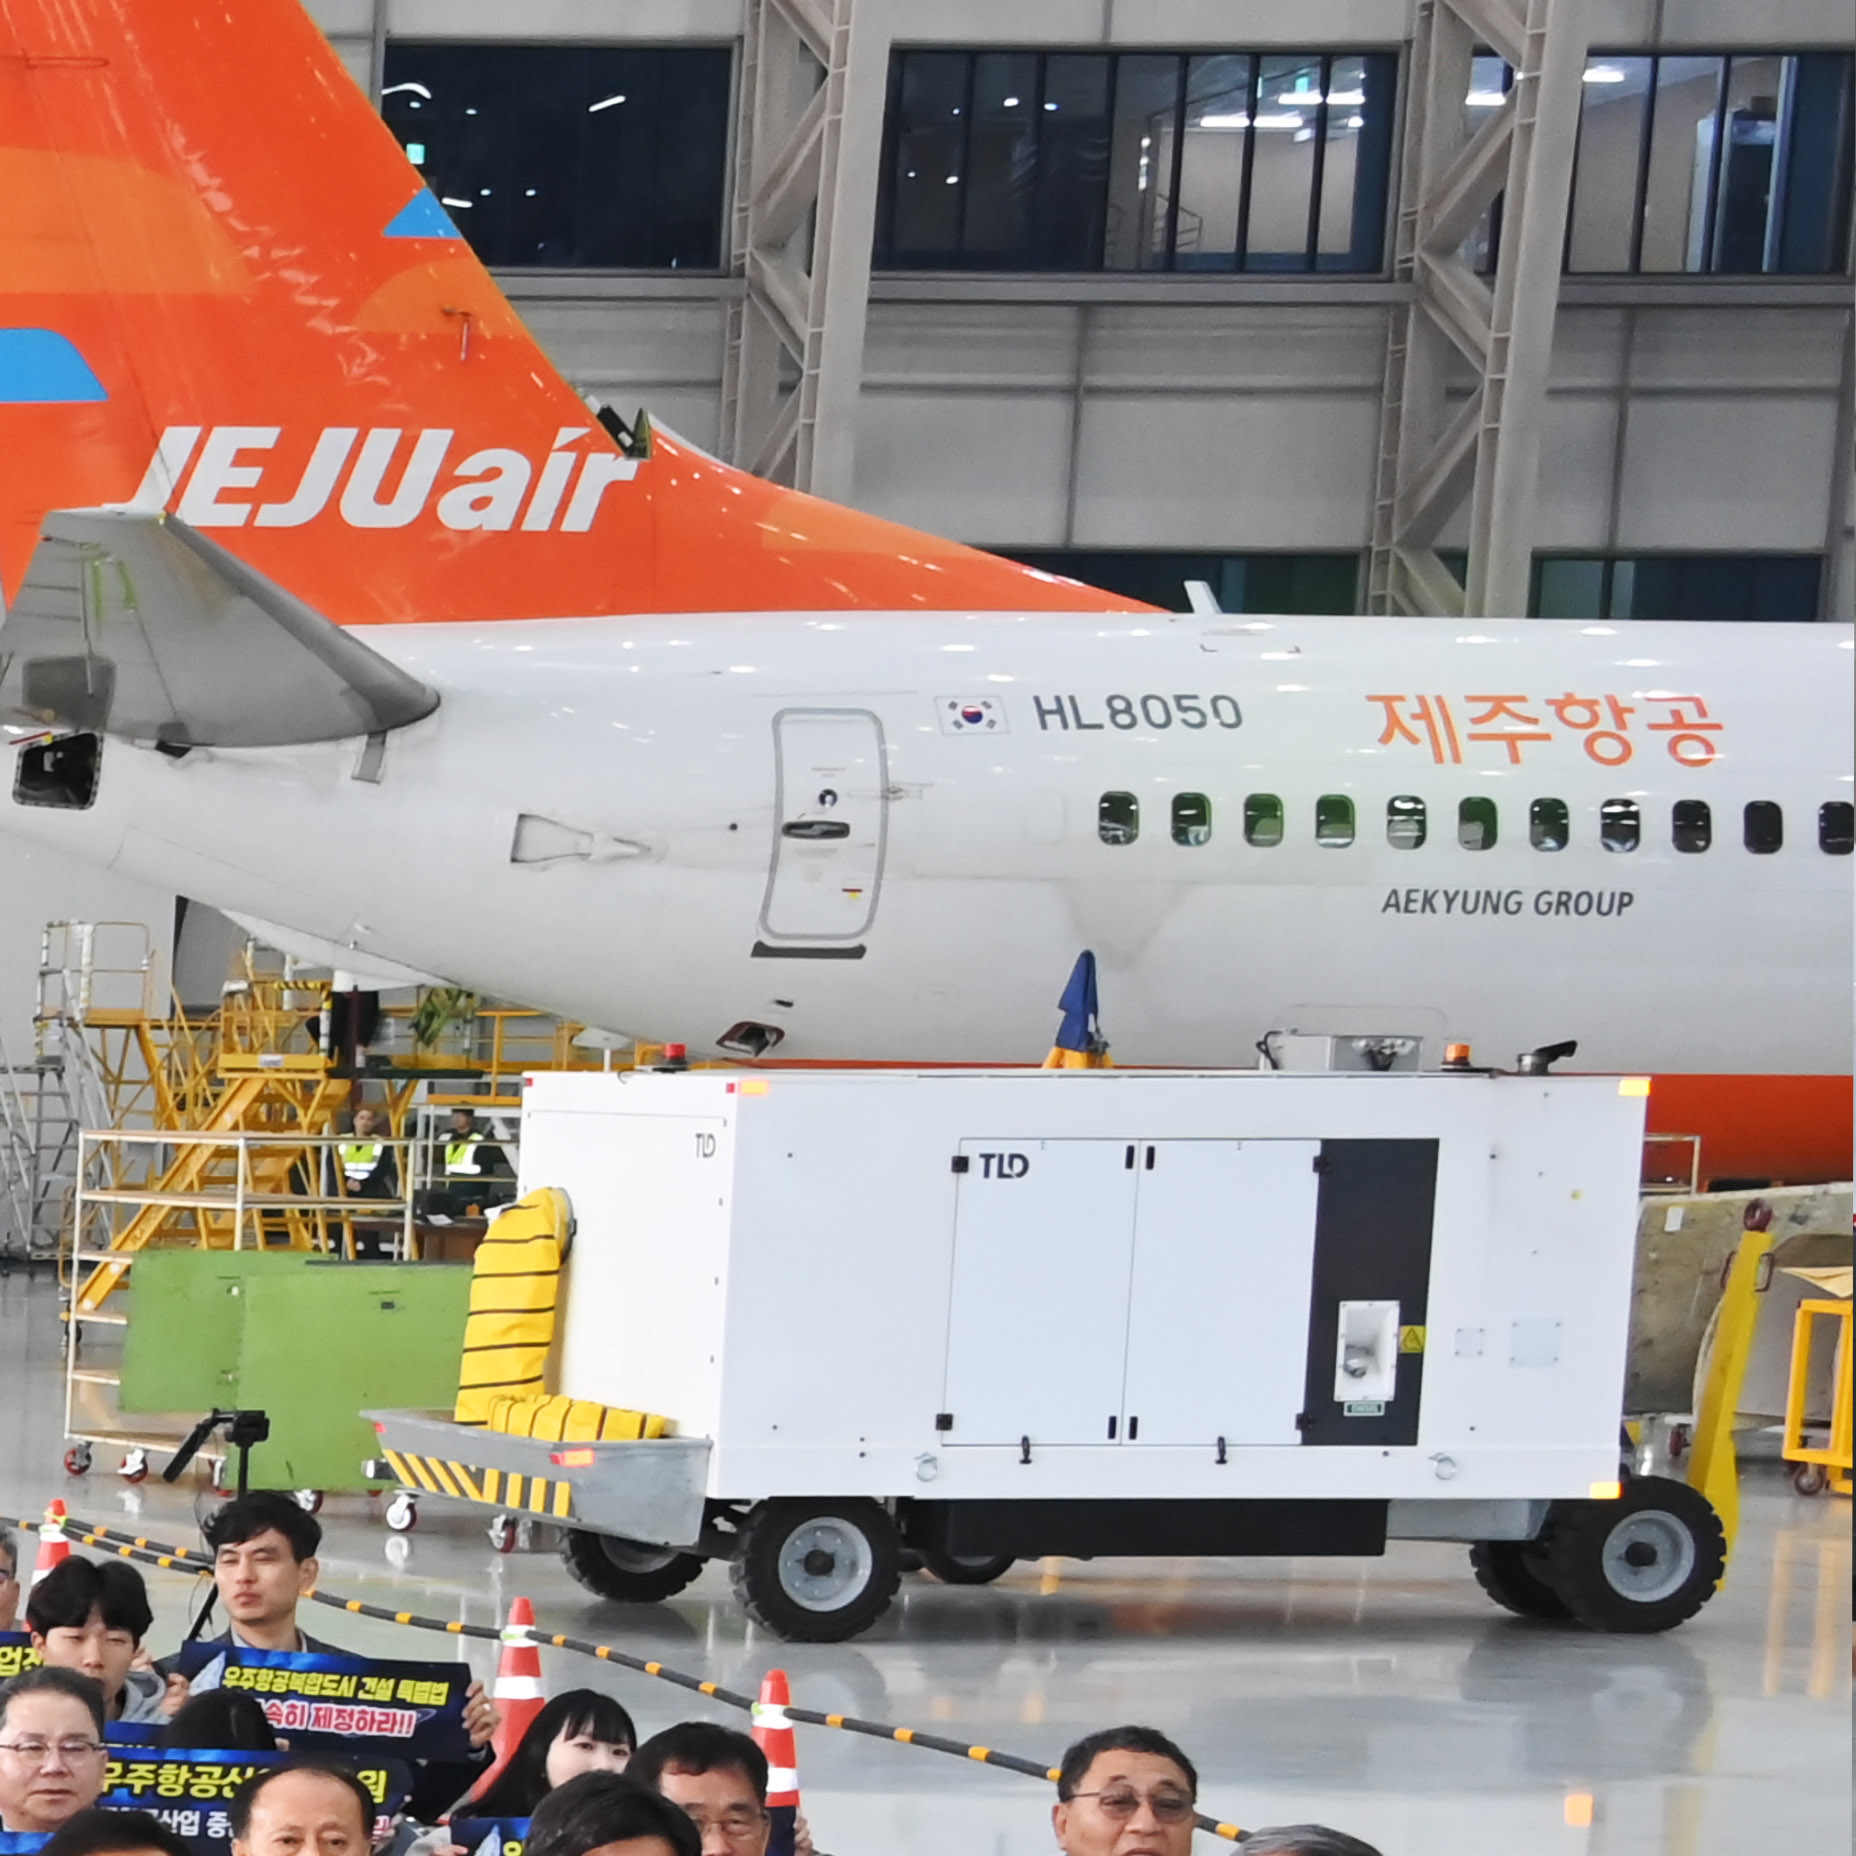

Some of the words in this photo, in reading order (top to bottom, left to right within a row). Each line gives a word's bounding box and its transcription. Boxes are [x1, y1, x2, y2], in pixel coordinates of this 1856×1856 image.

[100, 426, 640, 532] JEJUair
[1032, 694, 1244, 732] HL8050
[1366, 692, 1724, 767] 제주항공
[1380, 888, 1524, 916] AEKYUNG
[1533, 890, 1634, 917] GROUP
[695, 1133, 716, 1158] TLD
[979, 1153, 1030, 1178] TLD
[221, 1667, 355, 1698] 우주항공복합도시
[357, 1676, 394, 1701] 건설
[397, 1680, 449, 1706] 특별법
[308, 1703, 415, 1737] 제정하라!!
